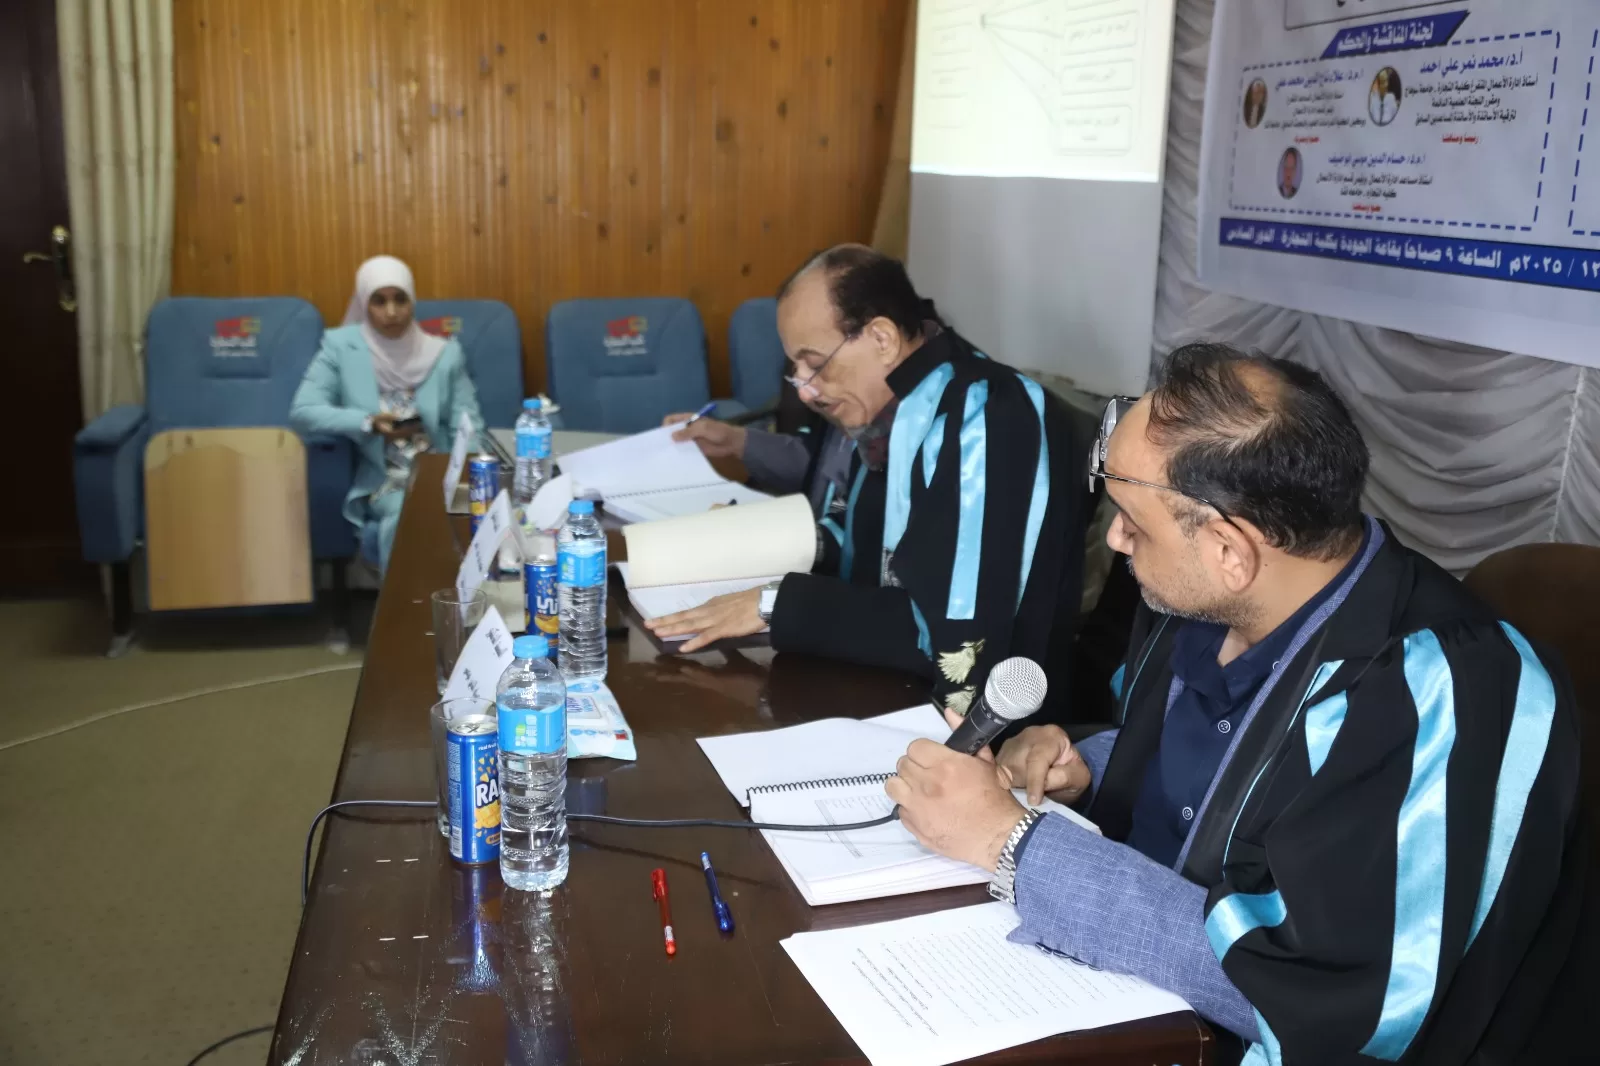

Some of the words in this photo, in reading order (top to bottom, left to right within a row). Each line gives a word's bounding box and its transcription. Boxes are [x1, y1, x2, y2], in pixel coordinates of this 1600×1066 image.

[1336, 31, 1373, 56] والحكم
[1372, 23, 1409, 47] المناقشة
[1409, 20, 1435, 47] لجنة
[1281, 228, 1313, 248] التجارة
[1314, 232, 1339, 253] بكلية
[1340, 234, 1373, 256] الجودة
[1373, 237, 1402, 261] بقاعة
[1446, 246, 1453, 263] ٩
[1457, 245, 1502, 269] الساعة
[1509, 254, 1562, 277] ٢٠٢٥م
[476, 778, 500, 807] RA
